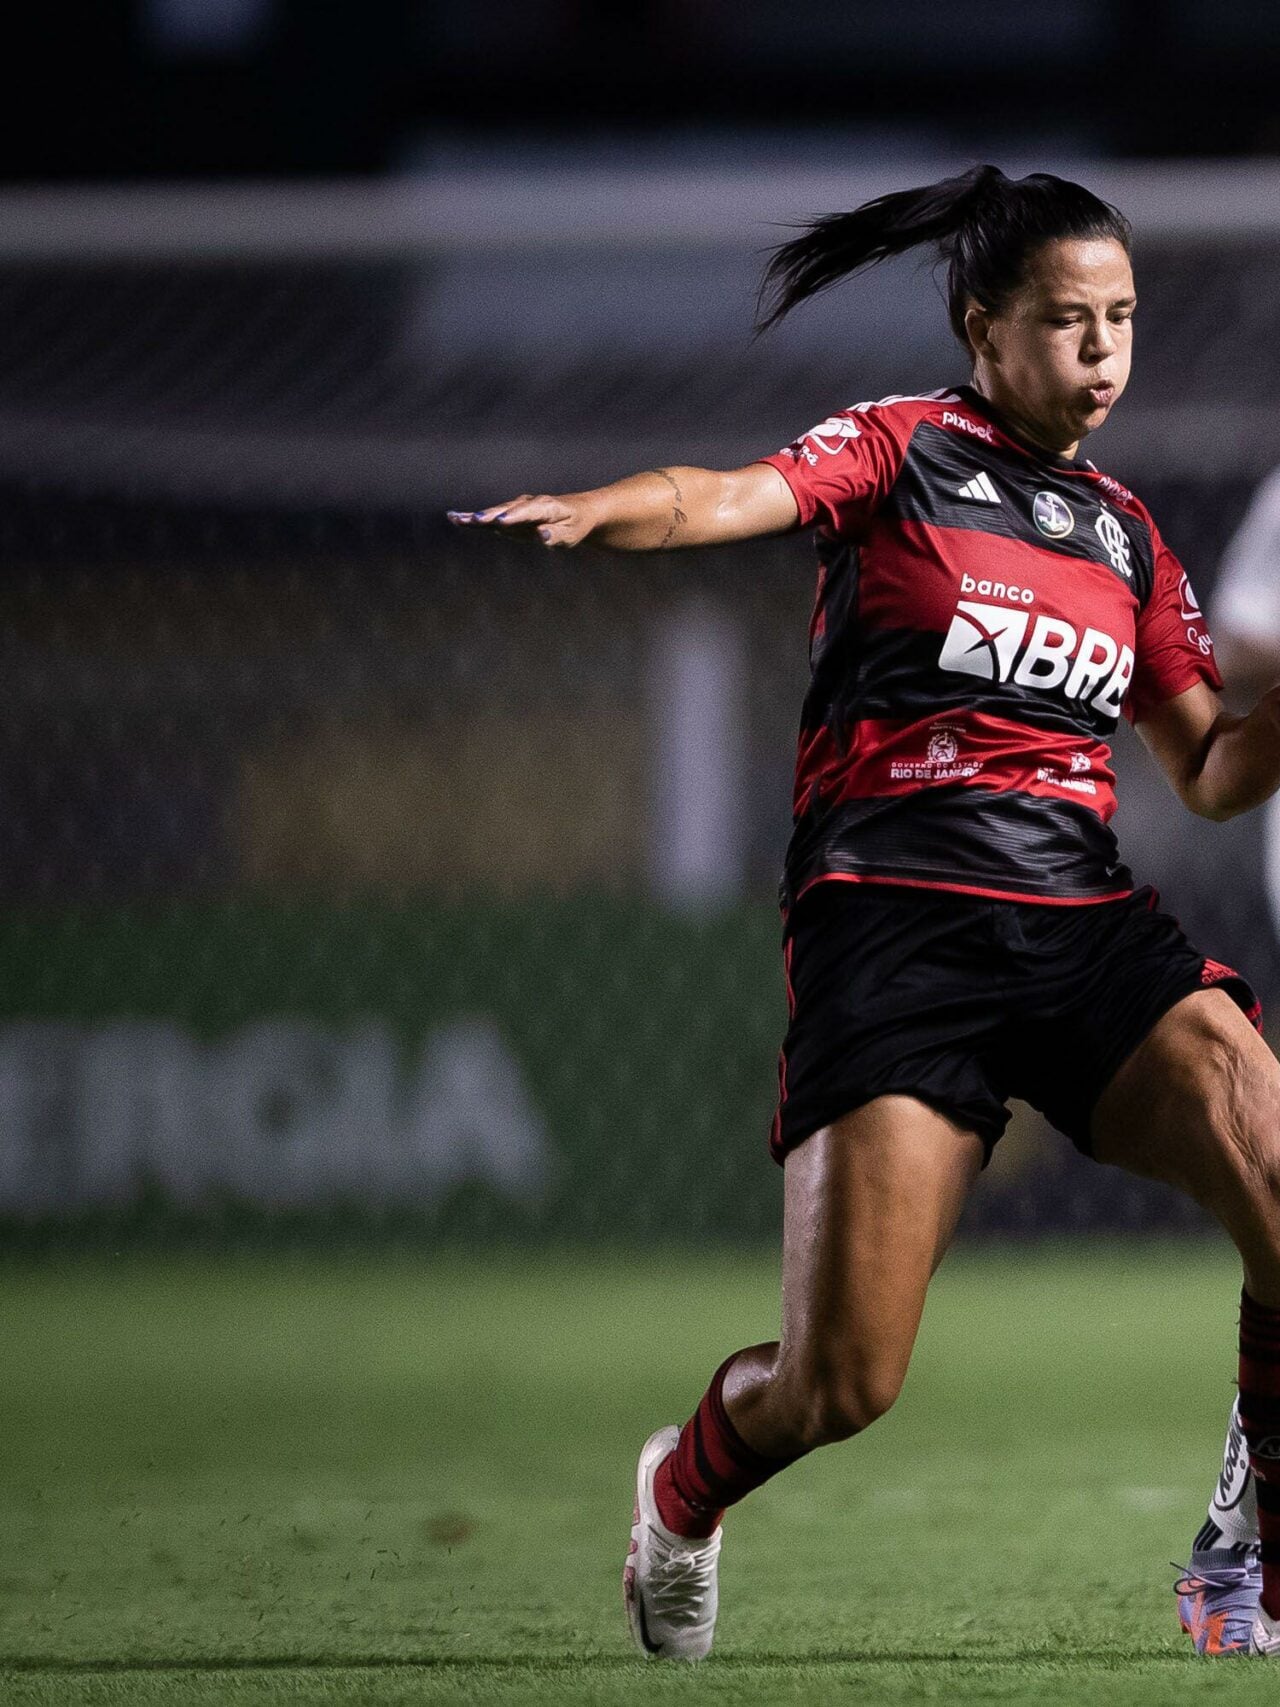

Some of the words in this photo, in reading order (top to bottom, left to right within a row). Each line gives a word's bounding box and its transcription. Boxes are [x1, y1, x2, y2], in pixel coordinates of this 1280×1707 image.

[942, 411, 994, 443] pixbet
[960, 573, 1035, 604] banco
[1013, 614, 1136, 719] BRB
[890, 768, 914, 779] RIO
[915, 769, 932, 780] DE
